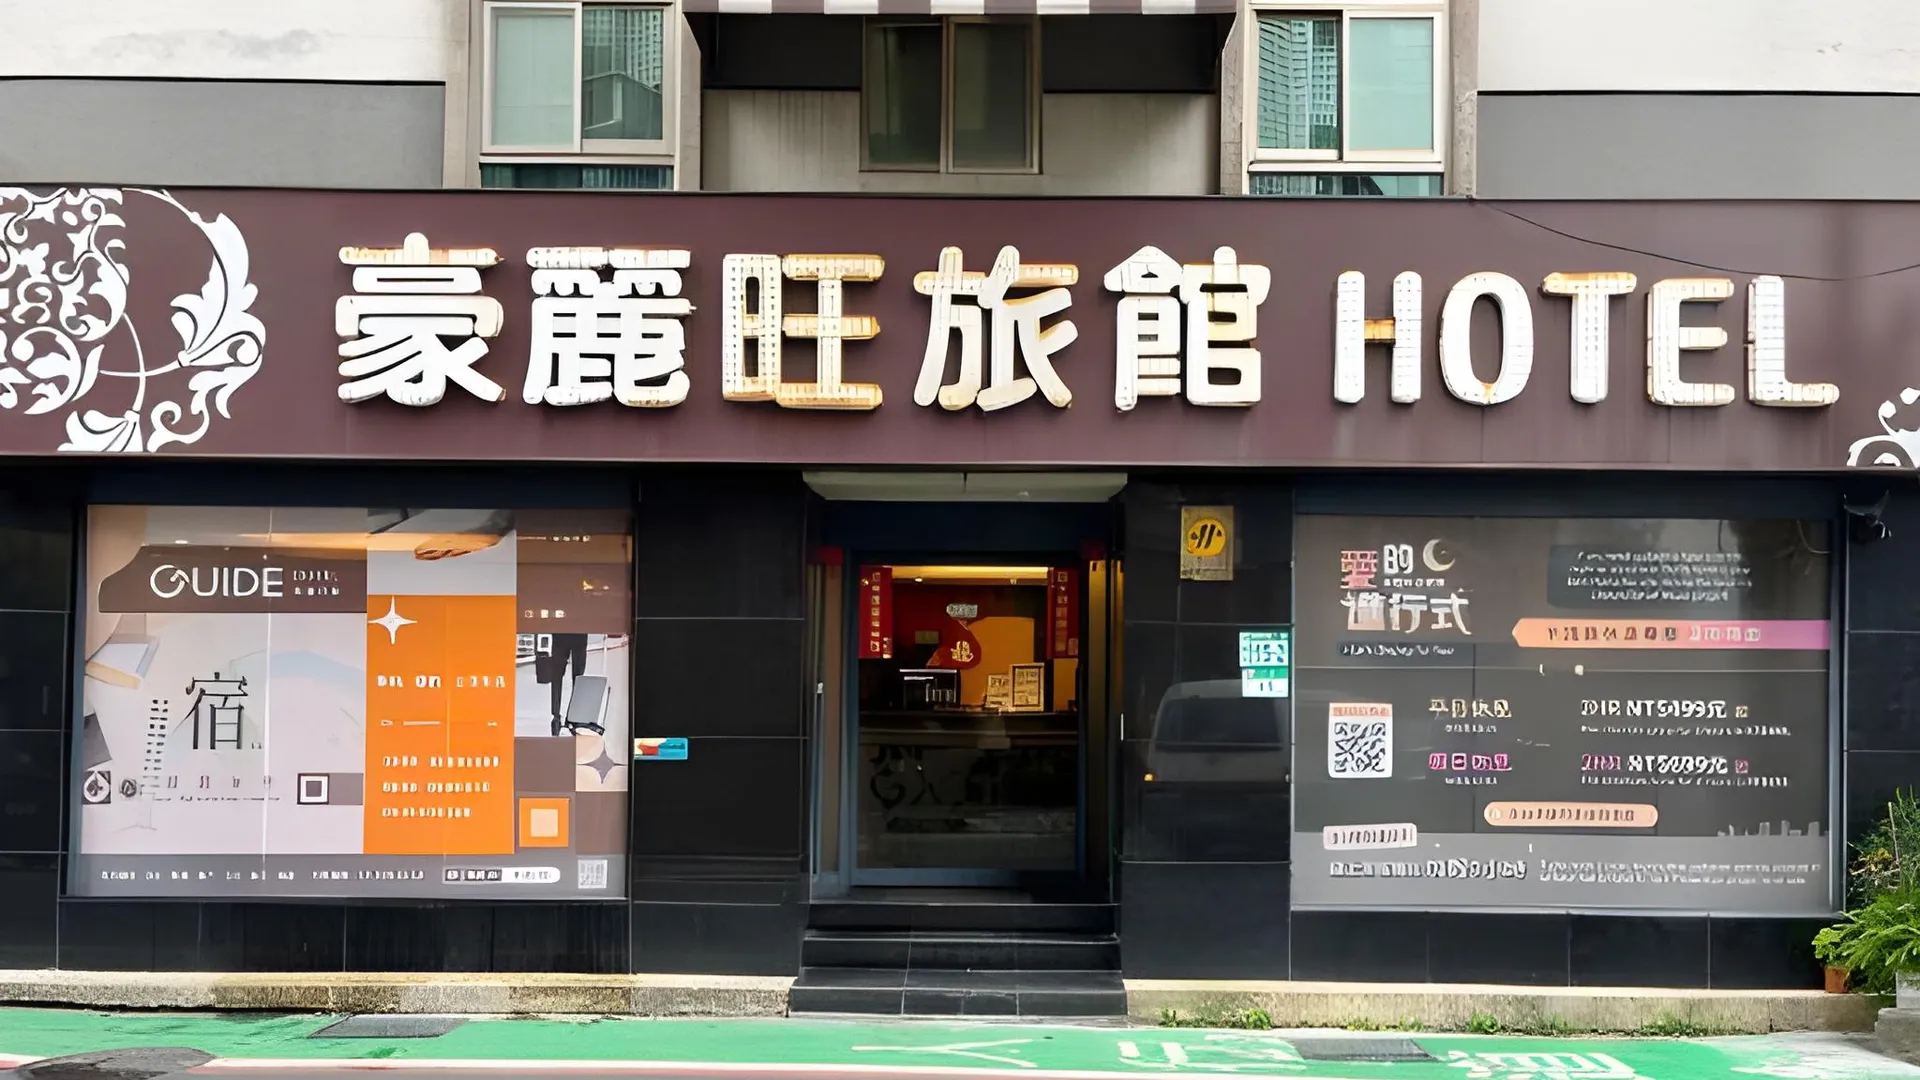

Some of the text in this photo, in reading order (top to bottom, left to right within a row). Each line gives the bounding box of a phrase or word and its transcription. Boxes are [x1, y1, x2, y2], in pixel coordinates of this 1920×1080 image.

[337, 232, 1841, 412] 豪麗旺旅館 HOTEL
[150, 565, 284, 598] GUIDE
